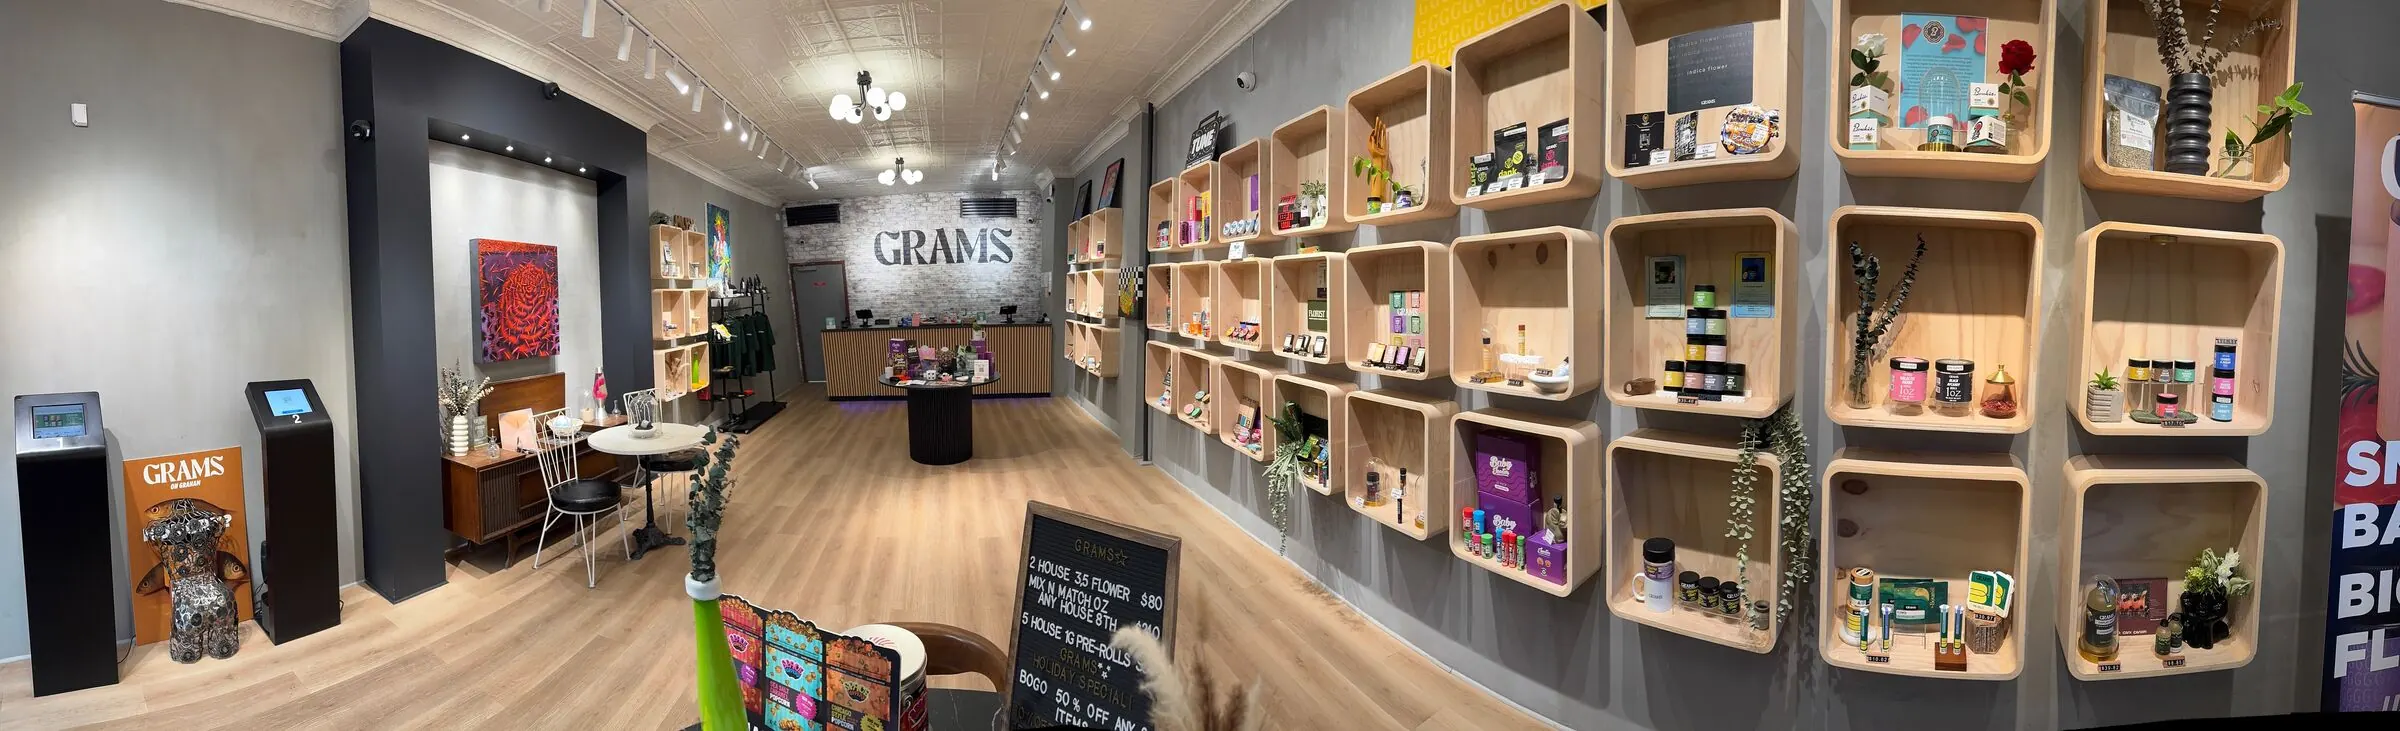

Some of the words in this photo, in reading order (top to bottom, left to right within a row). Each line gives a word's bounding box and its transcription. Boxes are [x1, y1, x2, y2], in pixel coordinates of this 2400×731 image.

[1686, 67, 1706, 76] indica
[1707, 64, 1728, 73] flower
[1191, 130, 1214, 154] TUNE
[873, 227, 1014, 266] GRAMS
[292, 414, 303, 424] 2
[57, 437, 63, 449] 1
[143, 455, 225, 485] GRAMS
[1489, 455, 1513, 470] Baby
[170, 481, 179, 490] ON
[1493, 514, 1517, 531] Baby
[1075, 538, 1114, 562] GRAMS
[1028, 574, 1045, 592] MIX
[1047, 582, 1055, 595] N
[1058, 584, 1092, 609] MATCH
[1093, 596, 1110, 614] OZ
[1029, 556, 1036, 569] 2
[1038, 559, 1071, 581] HOUSE
[1091, 577, 1131, 602] FLOWER
[1140, 592, 1163, 611] $80
[2338, 569, 2400, 619] BI
[1037, 591, 1058, 609] ANY
[1060, 599, 1094, 624] HOUSE
[1095, 612, 1118, 633] 8TH
[1021, 612, 1029, 625] 5
[1030, 616, 1062, 640] HOUSE
[1065, 629, 1075, 646] 1G
[1076, 634, 1131, 668] PRE-ROLLS
[1033, 652, 1077, 686] HOLIDAY
[1060, 647, 1098, 674] GRAMS
[769, 693, 791, 708] POPCORN
[1019, 669, 1048, 695] BOGO
[1055, 688, 1071, 707] 50
[1072, 697, 1081, 713] %
[1087, 703, 1111, 726] OFF
[1114, 716, 1136, 731] ANY
[831, 716, 854, 731] POPCORN
[1055, 706, 1089, 728] ITEMS
